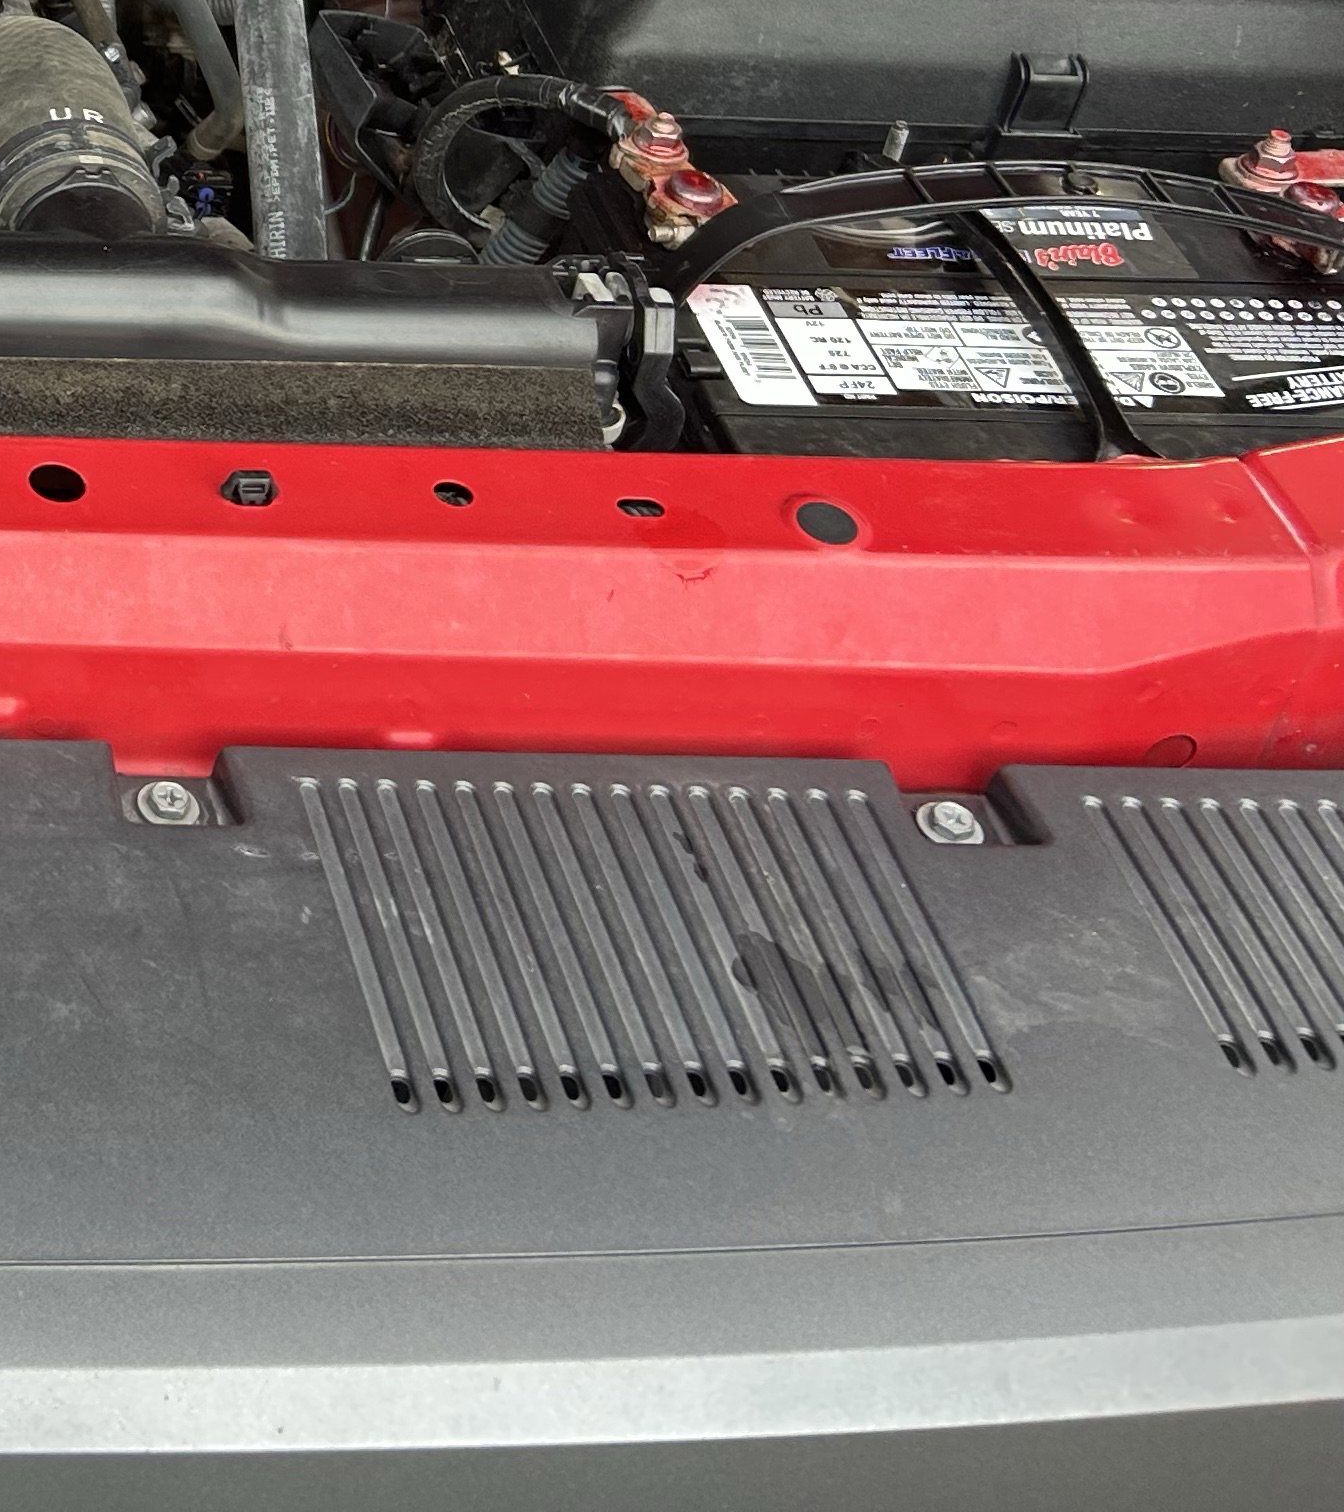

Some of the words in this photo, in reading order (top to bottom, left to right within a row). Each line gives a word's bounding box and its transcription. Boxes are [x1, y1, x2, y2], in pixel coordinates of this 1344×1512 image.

[1018, 220, 1154, 241] Platinum
[1034, 242, 1125, 271] Blain's
[793, 303, 824, 316] Pb
[851, 363, 877, 371] CCA
